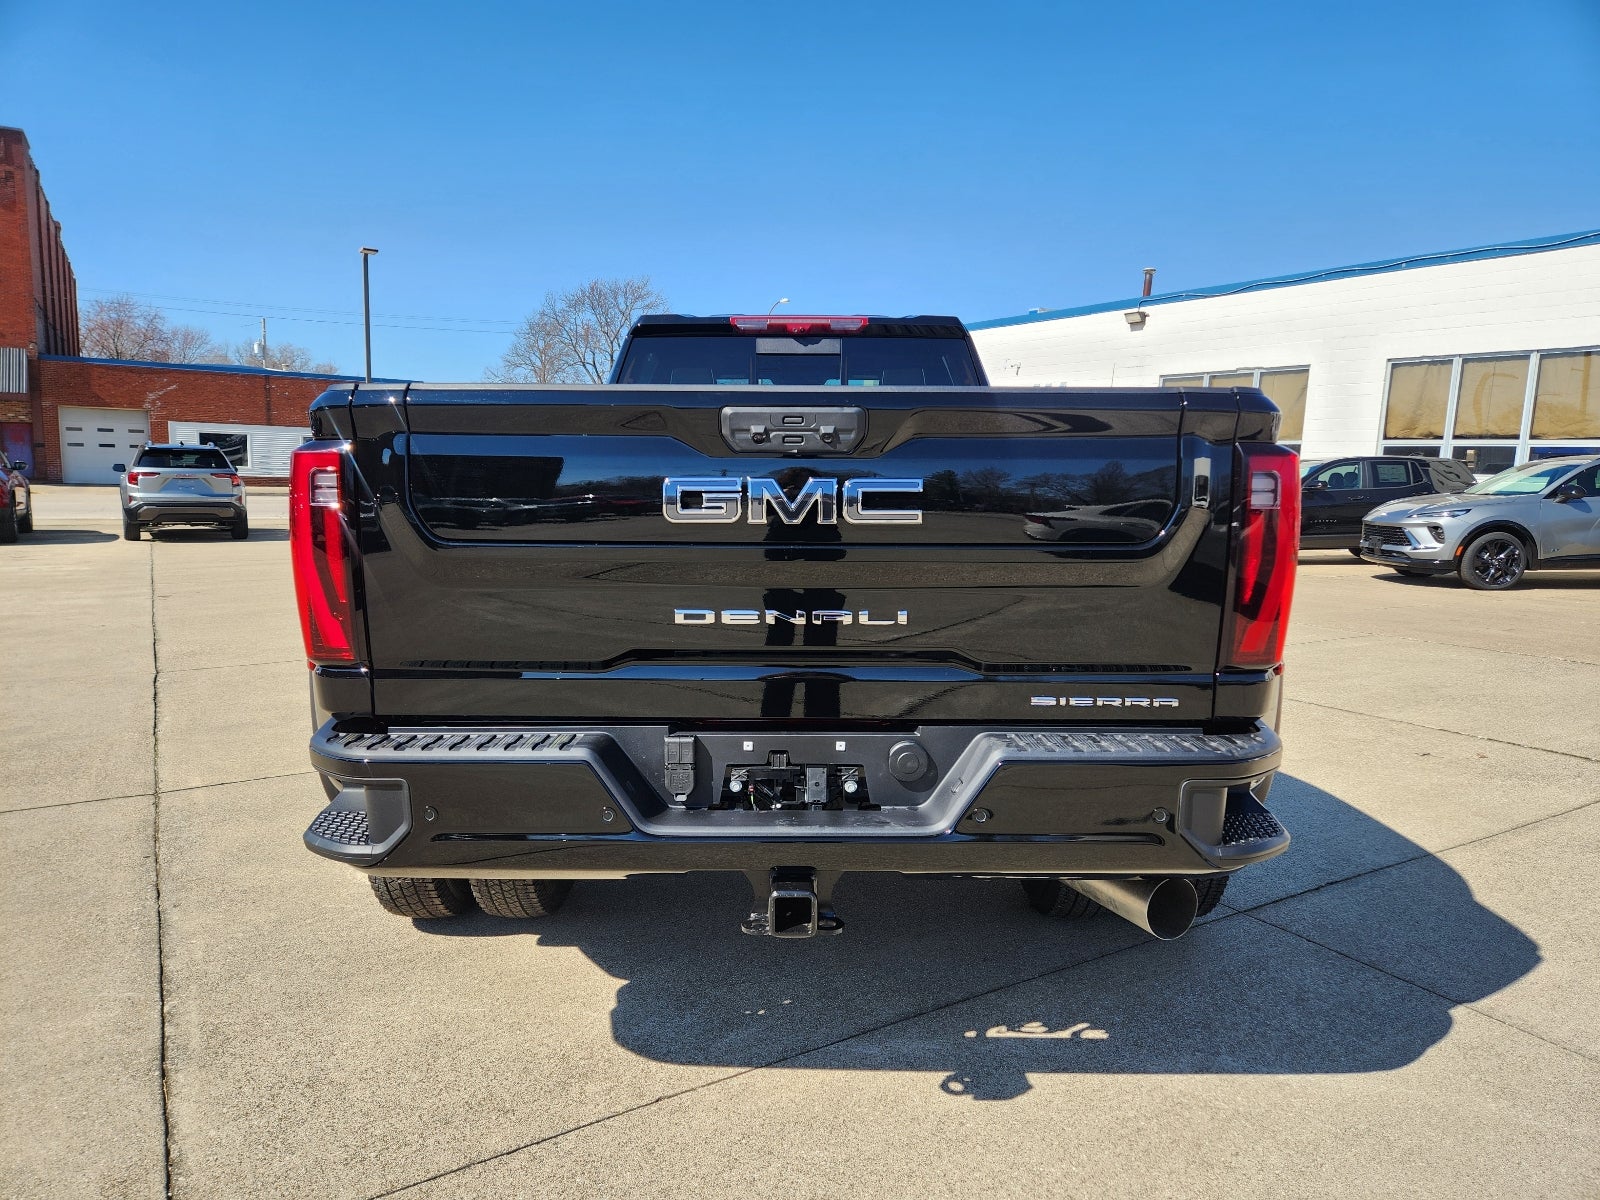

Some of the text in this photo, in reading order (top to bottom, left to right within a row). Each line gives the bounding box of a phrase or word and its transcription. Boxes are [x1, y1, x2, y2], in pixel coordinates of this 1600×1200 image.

[662, 476, 924, 525] GMC
[674, 608, 908, 625] DENALI
[1030, 696, 1180, 708] SIERRA
